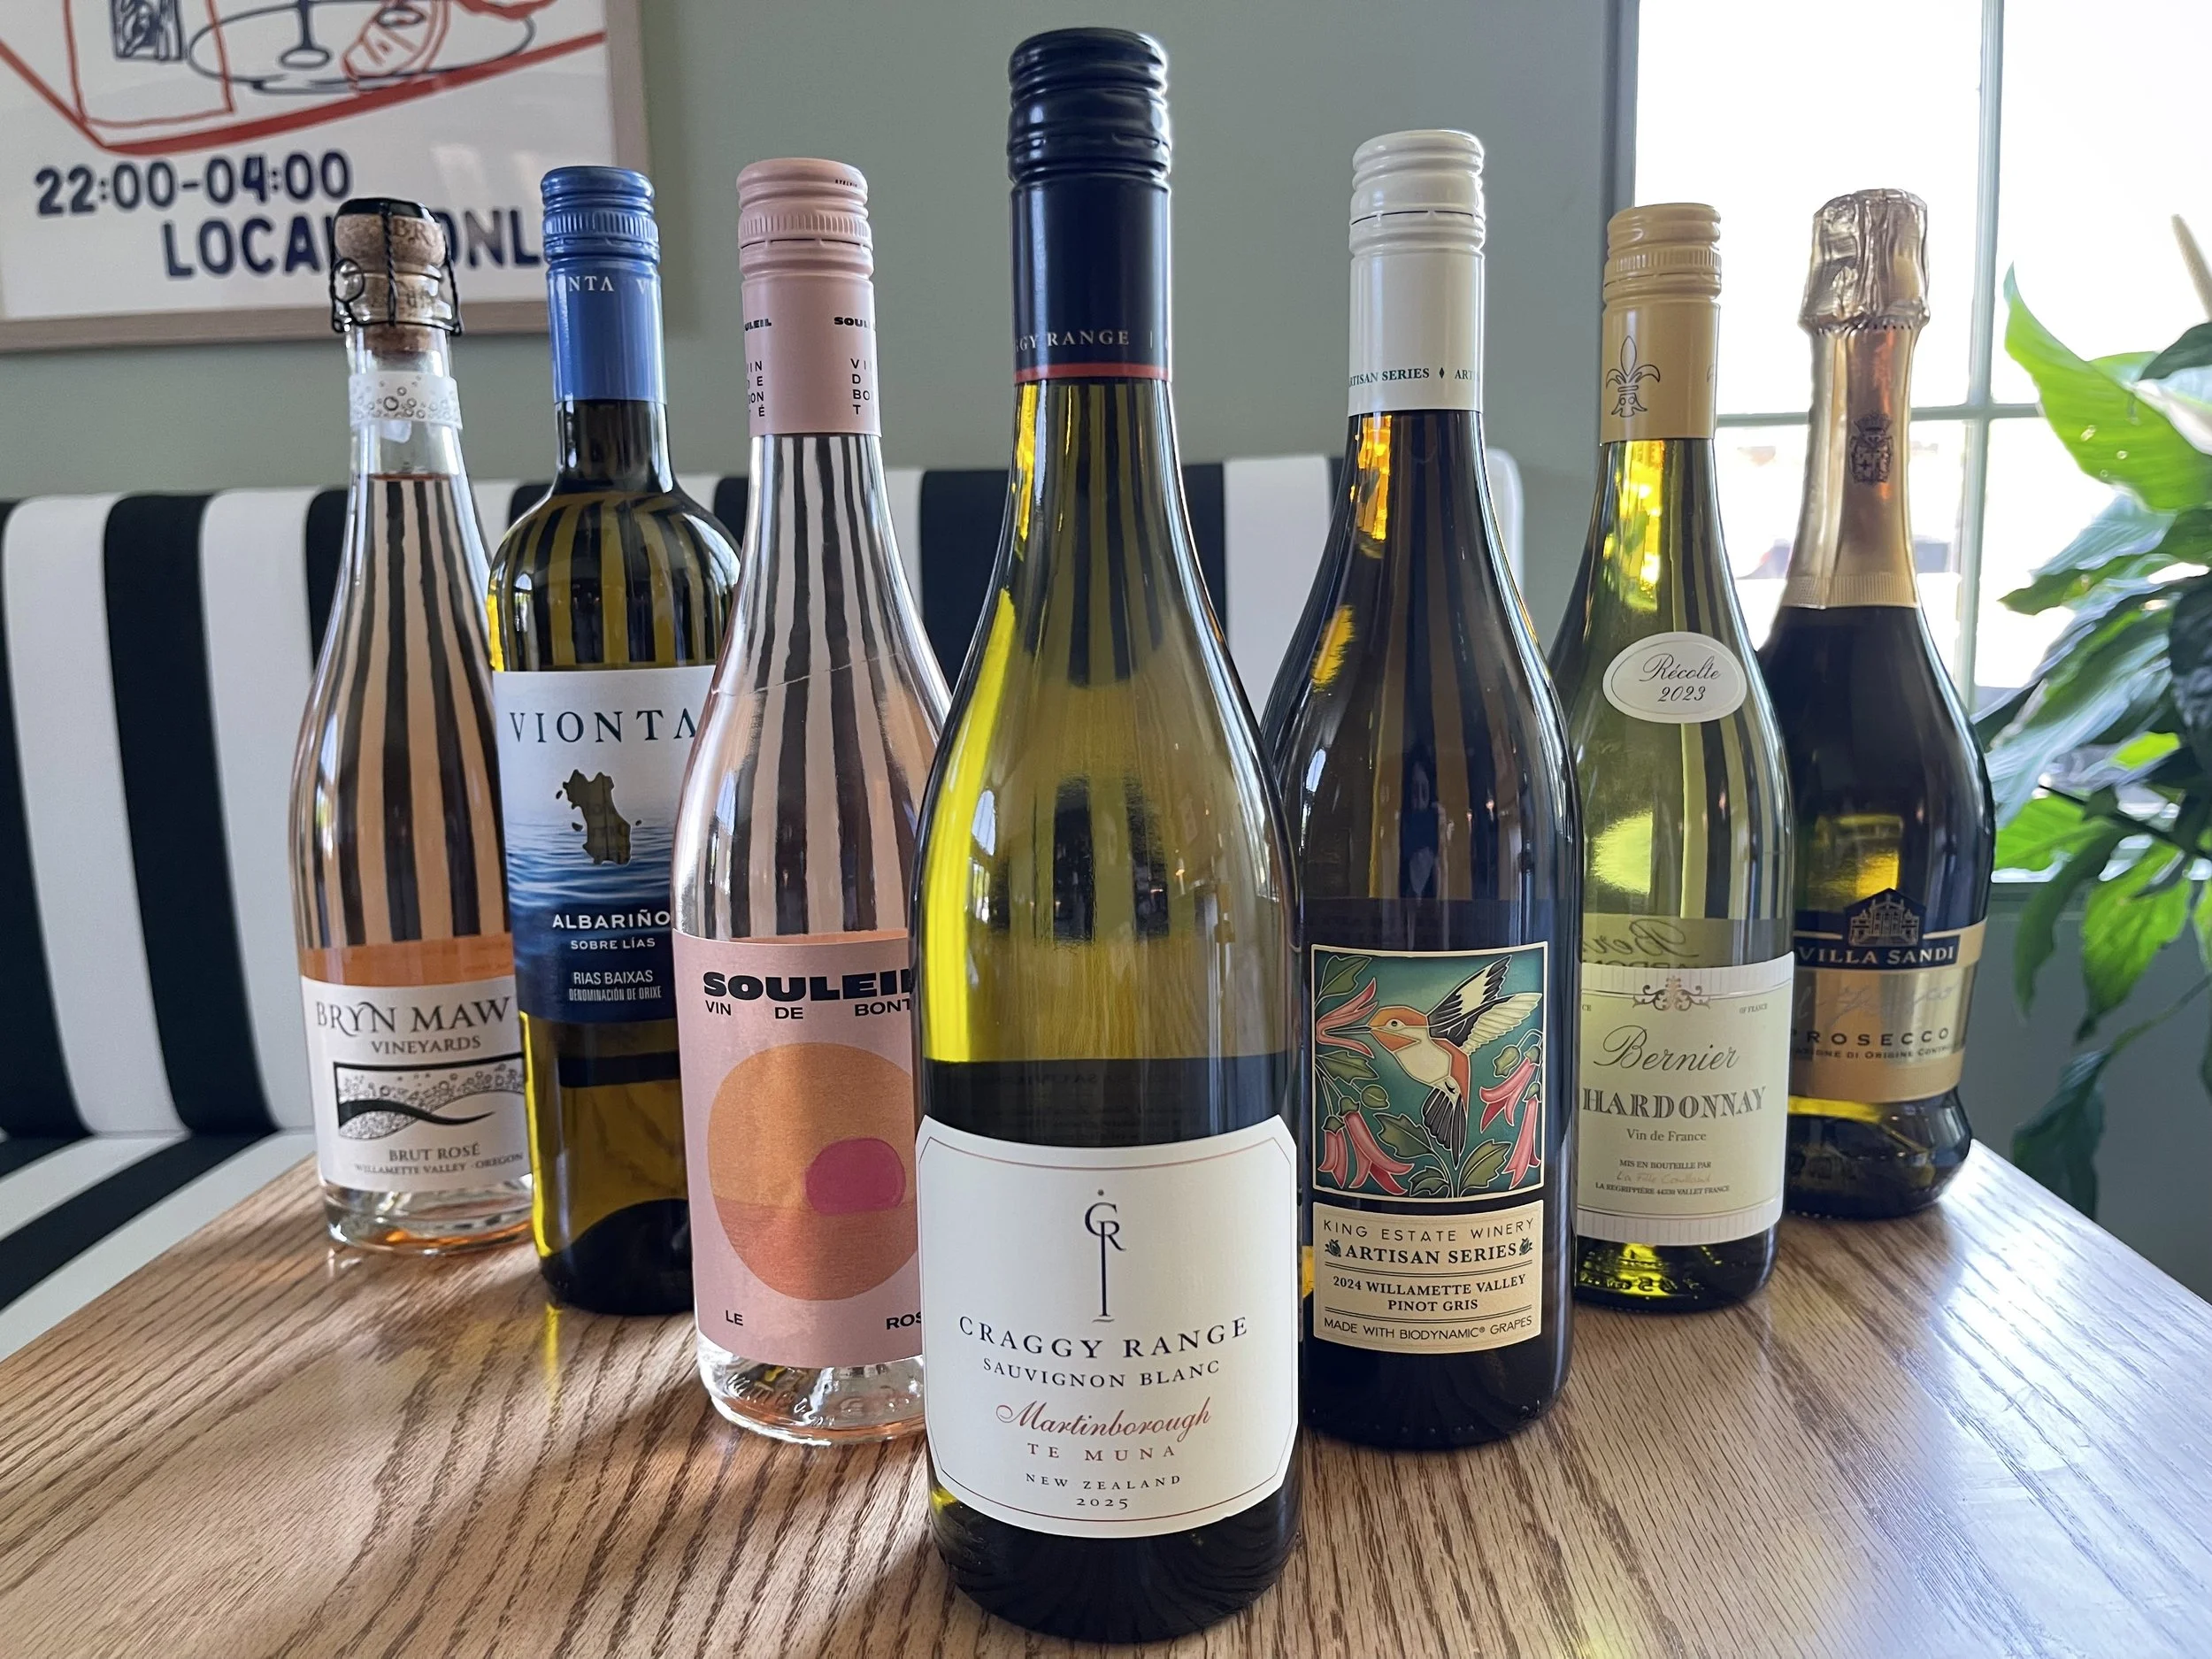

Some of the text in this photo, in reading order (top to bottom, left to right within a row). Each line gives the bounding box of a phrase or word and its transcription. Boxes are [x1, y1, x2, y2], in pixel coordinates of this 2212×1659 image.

[35, 151, 351, 216] 22:00-04:00
[161, 213, 334, 279] LOCA
[1047, 330, 1130, 347] RANGE
[1381, 368, 1430, 381] SERIES
[1639, 653, 1721, 681] Récolte
[1657, 686, 1706, 703] 2023
[510, 710, 698, 743] VIONTA
[552, 910, 671, 929] ALBARIÑO
[571, 937, 656, 949] SOBRE LÍAS
[1797, 945, 1955, 964] VILLA SANDI
[573, 970, 654, 985] RIAS BAIXAS
[626, 987, 636, 1001] DE
[639, 986, 662, 1000] ORIXE
[317, 996, 512, 1037] BRYN MAW
[705, 1000, 732, 1016] VIN
[775, 1007, 803, 1019] DE
[371, 1035, 481, 1054] VINEYARDS
[1792, 1027, 1950, 1046] ROSECCO
[1594, 1025, 1740, 1071] Bernier
[1583, 1086, 1766, 1119] HARDONNAY
[1626, 1128, 1707, 1141] Vin de France
[389, 1142, 480, 1162] BRUT ROSÉ
[423, 1162, 467, 1173] VALLEY
[1324, 1217, 1534, 1241] KING ESTATE WINERY
[1346, 1242, 1517, 1264] ARTISAN SERIES
[1333, 1273, 1526, 1296] 2024 WILLAMETTE VALLEY
[1387, 1299, 1479, 1311] PINOT GRIS
[726, 1310, 744, 1326] LE
[1325, 1317, 1357, 1333] MADE
[1363, 1325, 1394, 1338] WITH
[1490, 1316, 1532, 1334] GRAPES
[960, 1316, 1248, 1358] CRAGGY RANGE
[983, 1357, 1220, 1388] SAUVIGNON BLANC
[995, 1396, 1211, 1442] Martinborough
[1027, 1442, 1176, 1462] TE MUNA
[1025, 1472, 1180, 1490] NEW ZEALAND
[1076, 1497, 1129, 1509] 2025
